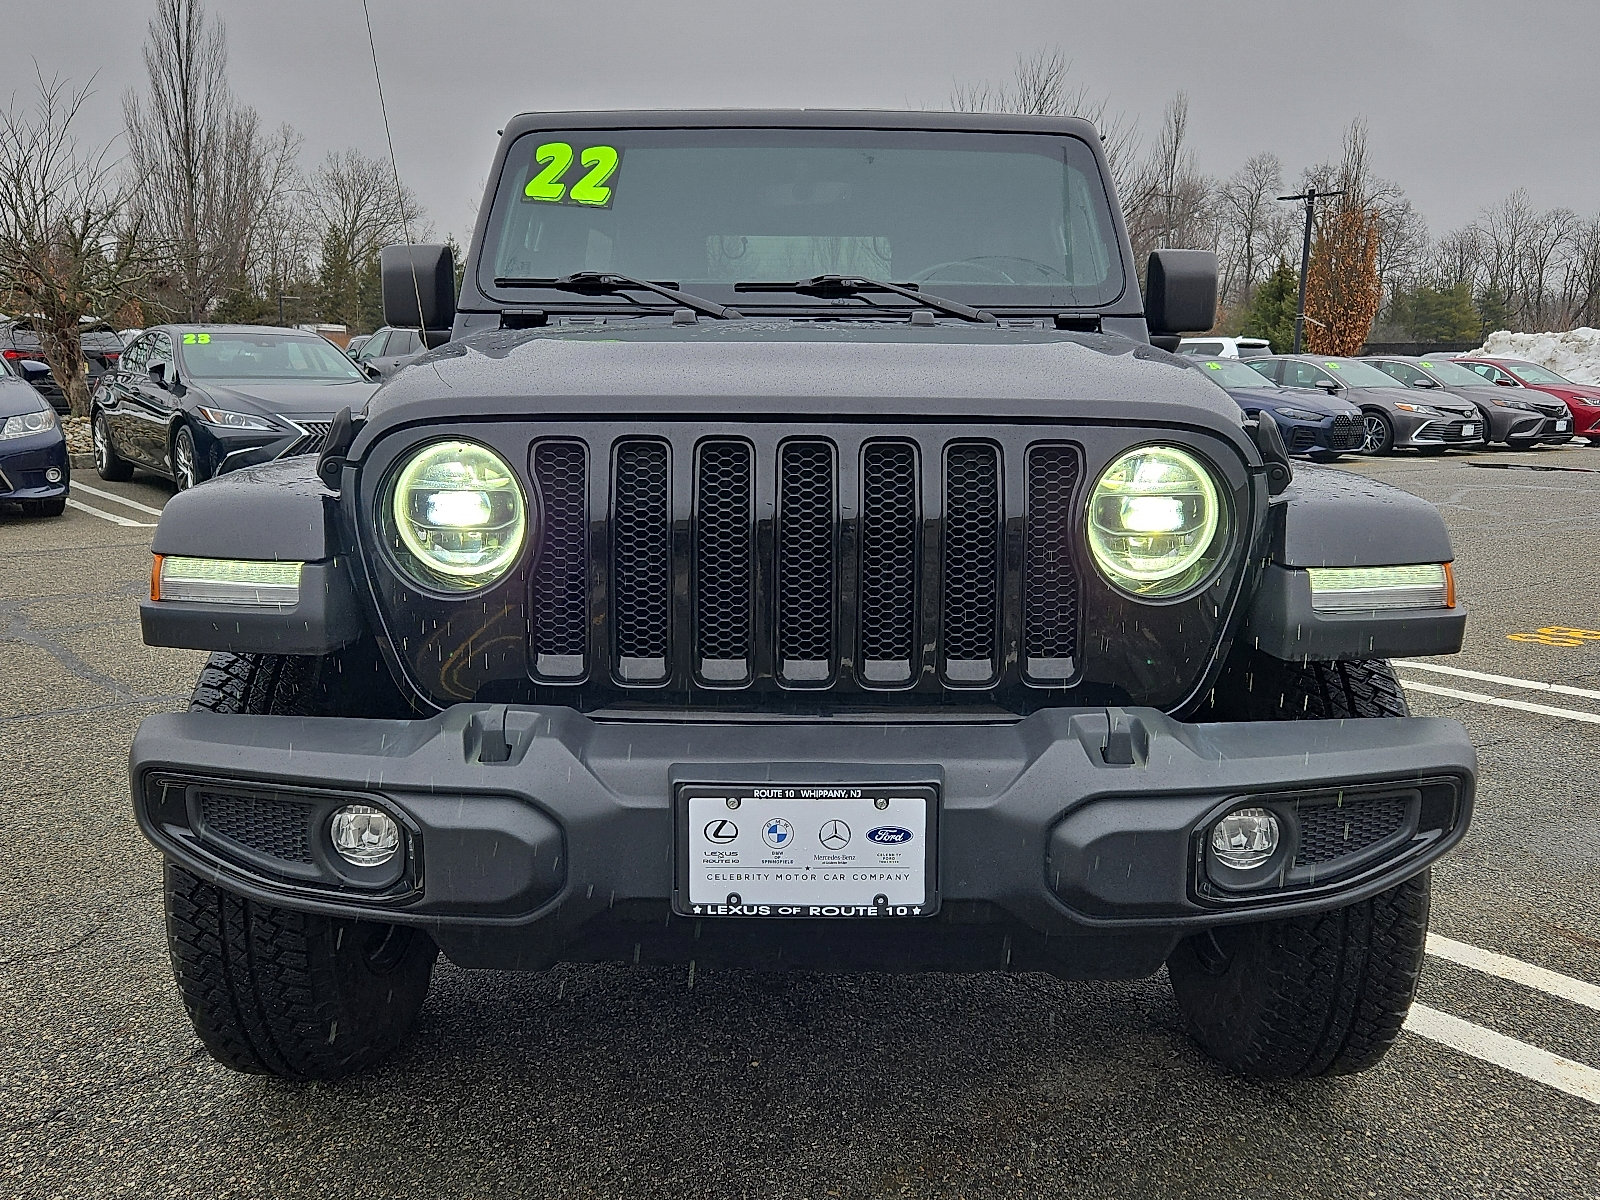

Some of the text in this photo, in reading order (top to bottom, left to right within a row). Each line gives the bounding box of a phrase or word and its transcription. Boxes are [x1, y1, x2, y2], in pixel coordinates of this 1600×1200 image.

[524, 142, 619, 205] 22
[183, 333, 211, 345] 23
[753, 789, 861, 799] ROUTE 10 WHIPPANY, NJ
[874, 829, 905, 842] Ford
[707, 905, 908, 916] LEXUS OF ROUTE 10
